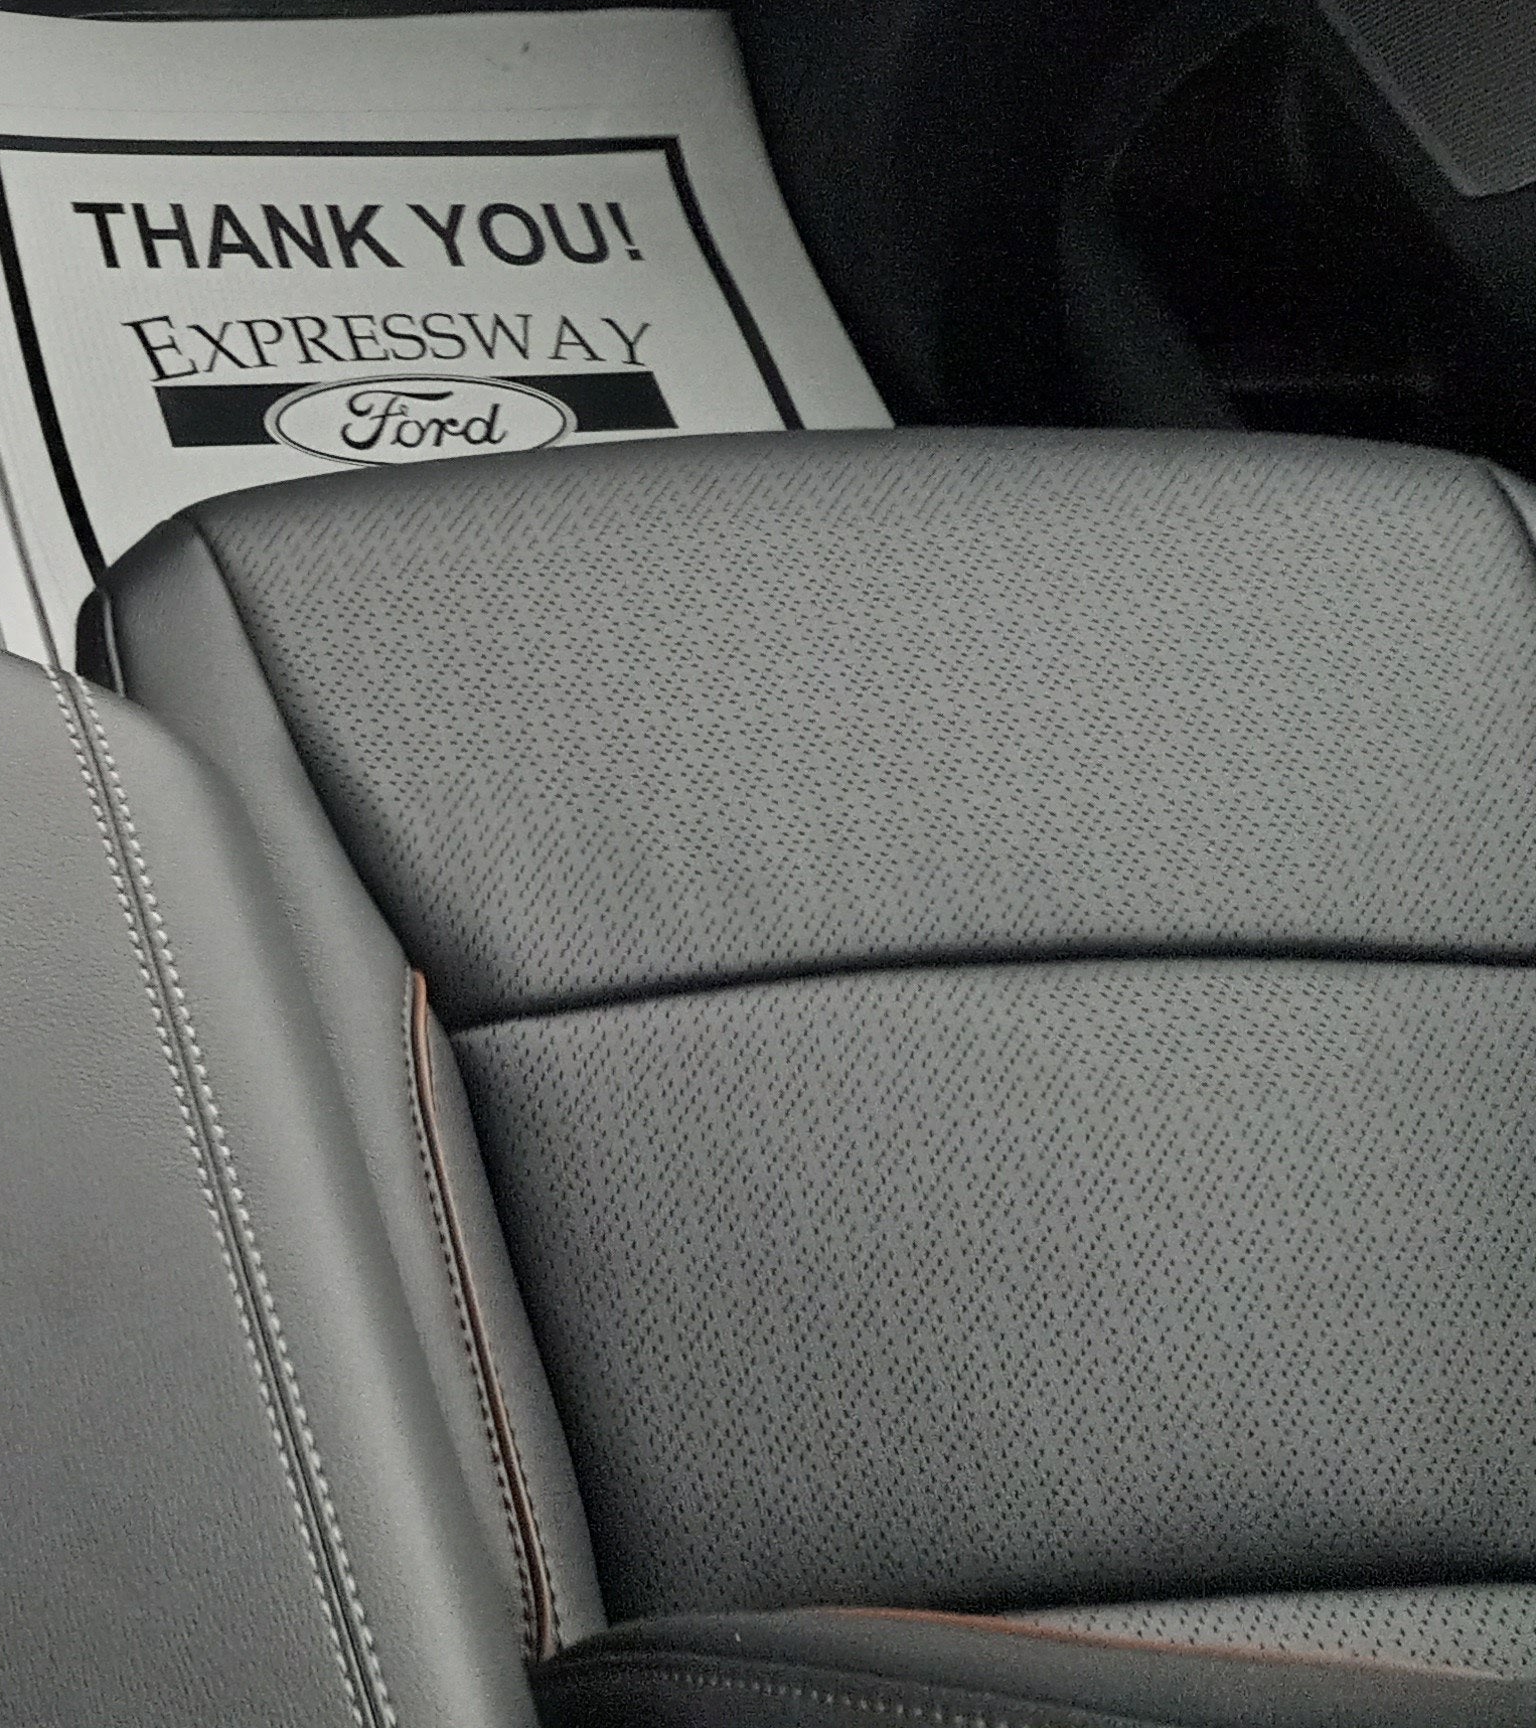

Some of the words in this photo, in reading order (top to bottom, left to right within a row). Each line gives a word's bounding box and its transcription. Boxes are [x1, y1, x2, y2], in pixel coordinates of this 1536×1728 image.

[71, 201, 406, 269] THANK
[407, 200, 646, 268] YOU!
[121, 312, 654, 383] EXPRESSWAY
[338, 388, 510, 452] Ford
